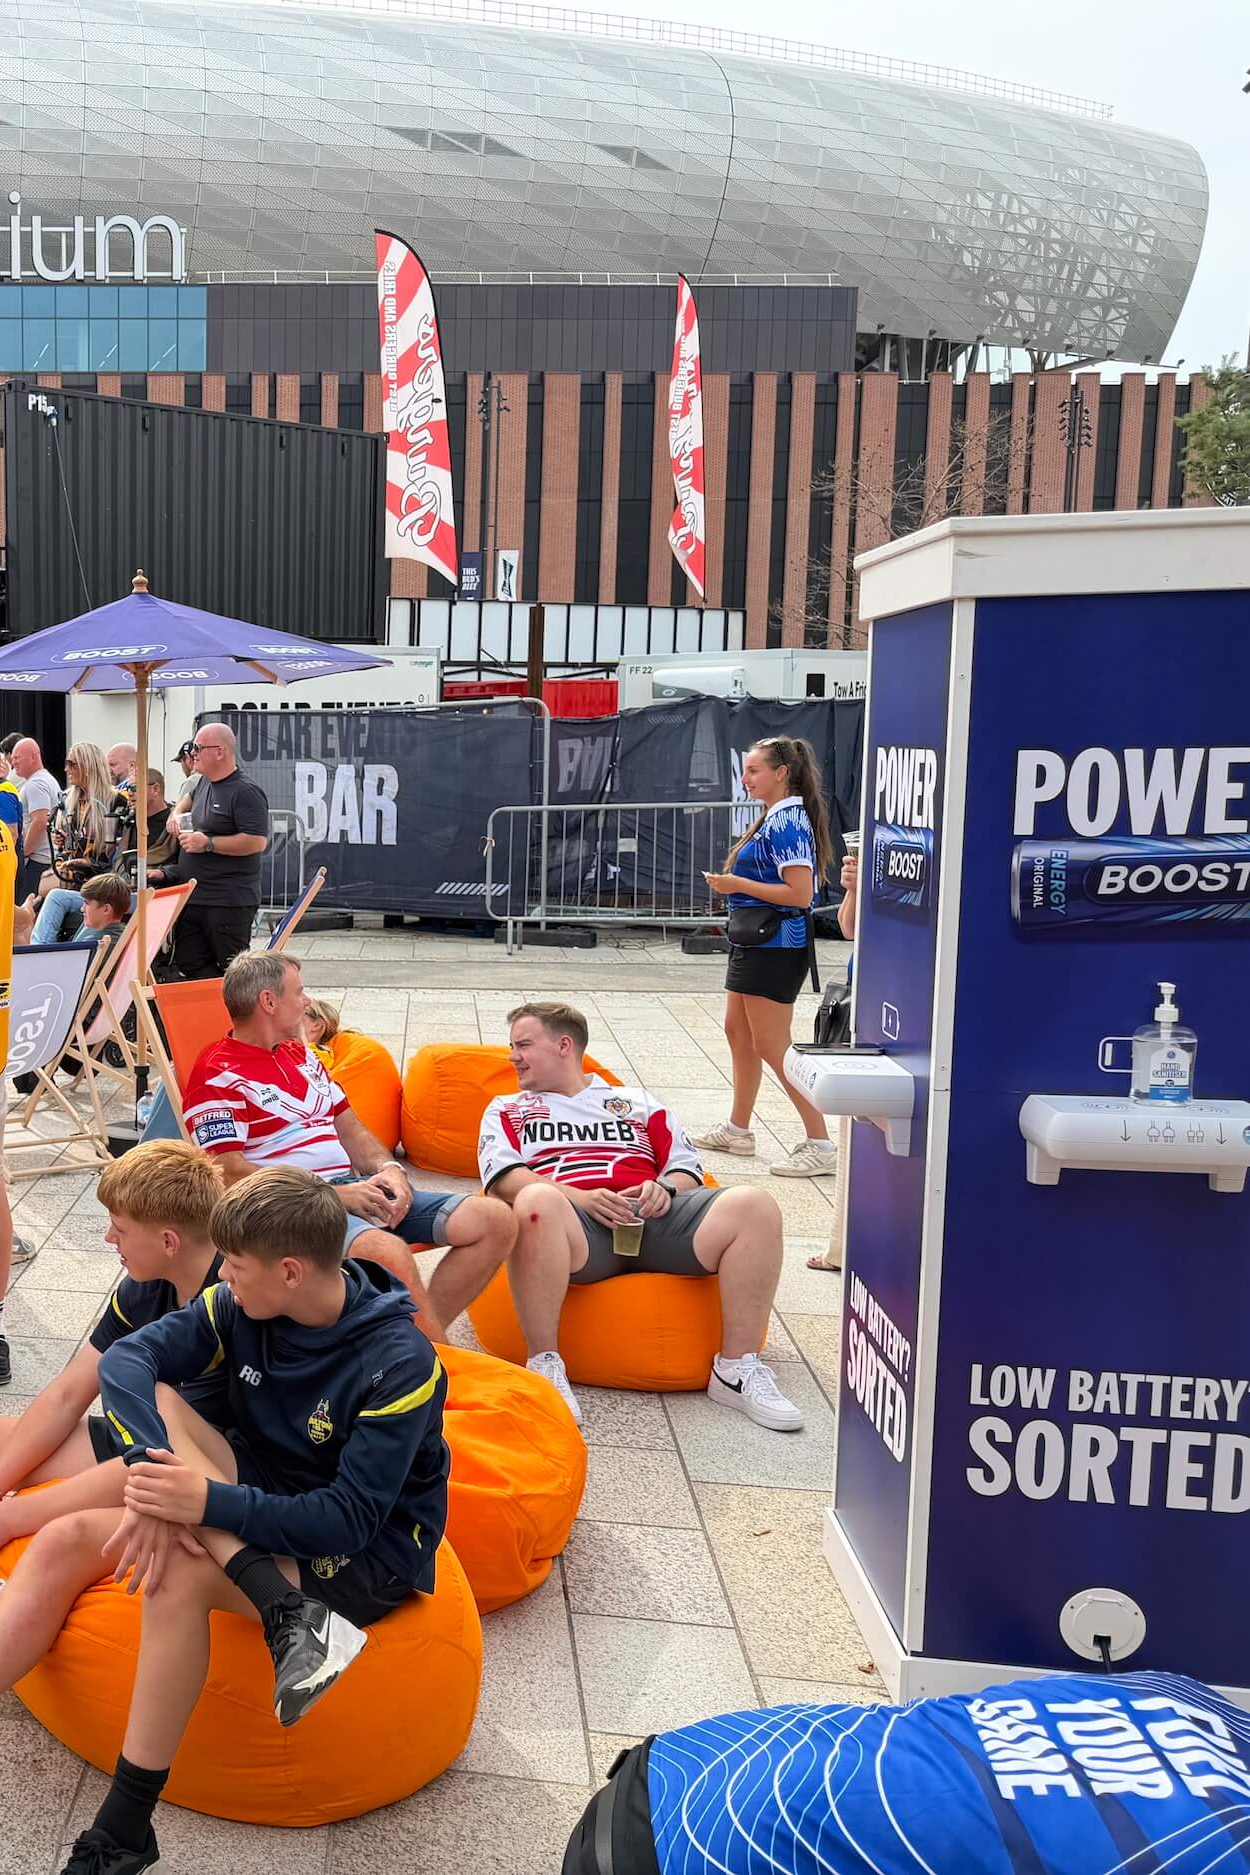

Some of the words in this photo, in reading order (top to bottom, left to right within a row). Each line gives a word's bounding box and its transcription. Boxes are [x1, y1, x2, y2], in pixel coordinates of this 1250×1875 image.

[63, 646, 159, 661] BOOST
[630, 666, 641, 675] FF
[642, 666, 653, 674] 22
[295, 761, 399, 846] BAR
[874, 746, 937, 831] POWER
[888, 850, 924, 881] BOOST
[1032, 856, 1046, 908] ORIGINAL
[1050, 849, 1070, 916] ENERGY
[1097, 862, 1250, 895] BOOST
[194, 1109, 232, 1126] BETFRED
[208, 1122, 234, 1133] SUPER
[209, 1130, 236, 1139] LEAGUE
[523, 1120, 636, 1145] NORWEB
[849, 1270, 866, 1315] LOW
[868, 1292, 912, 1378] BATTERY?
[238, 1364, 263, 1387] RG
[847, 1317, 907, 1464] SORTED
[969, 1363, 1057, 1410] LOW
[1068, 1370, 1250, 1422] BATTERY
[966, 1415, 1250, 1514] SORTED
[965, 1698, 1082, 1800] GAME
[1045, 1697, 1174, 1799] YOUR
